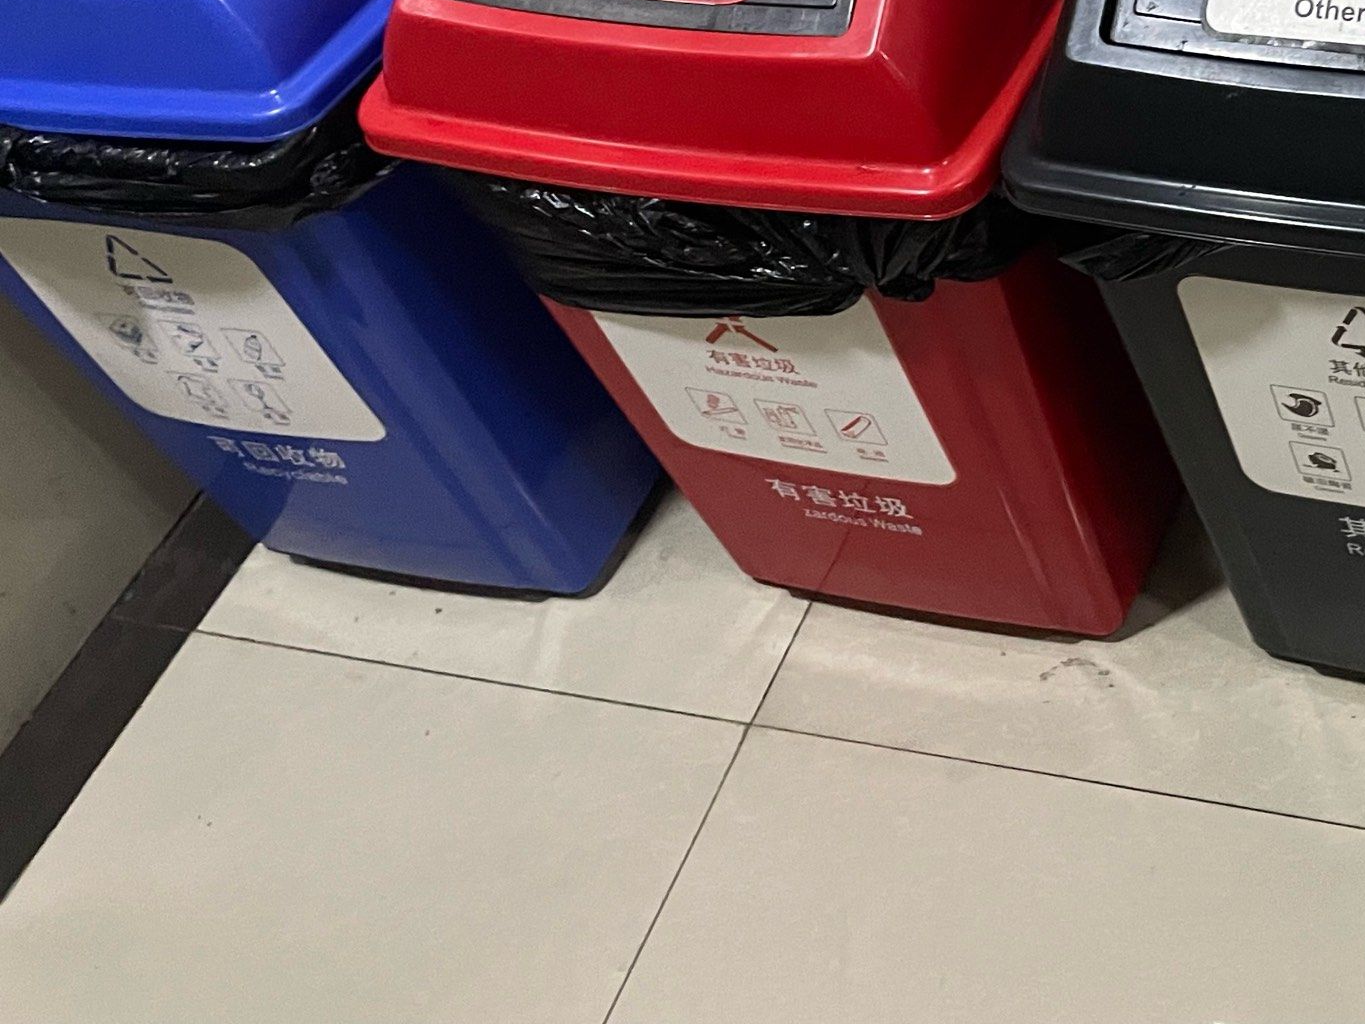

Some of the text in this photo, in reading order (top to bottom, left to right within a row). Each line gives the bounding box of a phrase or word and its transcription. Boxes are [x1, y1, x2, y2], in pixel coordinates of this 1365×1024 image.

[706, 350, 800, 375] 有害垃圾
[206, 435, 346, 469] 可回收物
[764, 479, 914, 519] 有害垃圾
